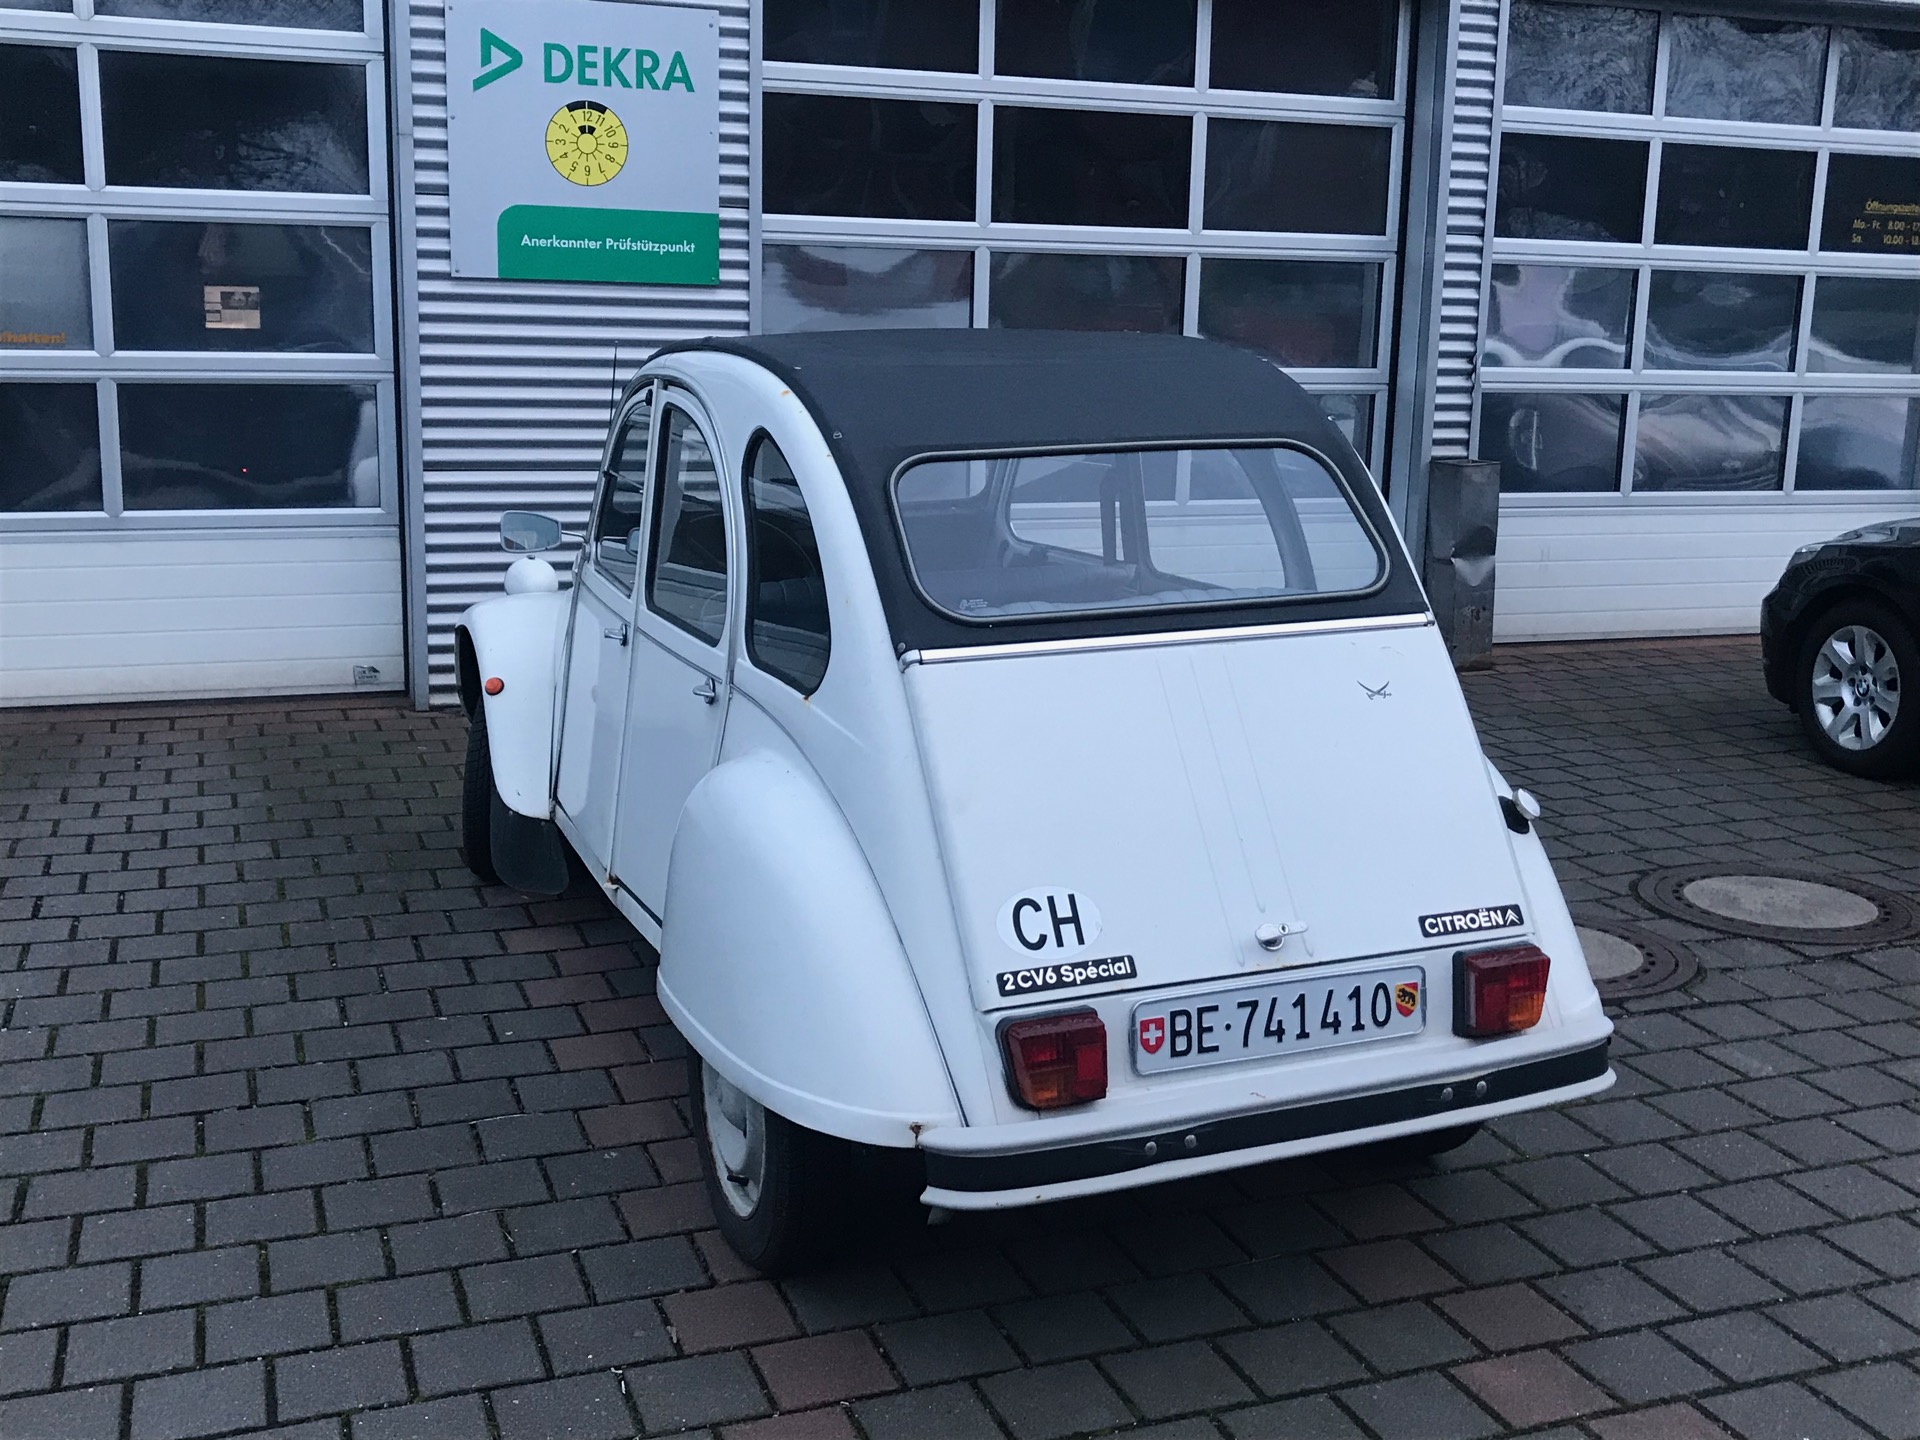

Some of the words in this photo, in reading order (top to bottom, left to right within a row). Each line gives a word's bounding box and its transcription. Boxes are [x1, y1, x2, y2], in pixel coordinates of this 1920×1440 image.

[543, 42, 695, 93] DEKRA
[570, 114, 577, 124] 1
[582, 111, 593, 122] 12
[595, 114, 606, 127] 11
[558, 124, 570, 133] 2
[604, 125, 617, 138] 10
[554, 138, 566, 146] 3
[604, 154, 616, 163] 8
[569, 161, 579, 172] 5
[584, 165, 591, 177] 6
[598, 162, 606, 174] 7
[521, 234, 601, 250] Anerkannter
[605, 238, 696, 255] Prüfstützpunkt
[1012, 893, 1085, 951] CH
[1424, 908, 1504, 934] CITROËN
[1060, 957, 1131, 984] Spécial
